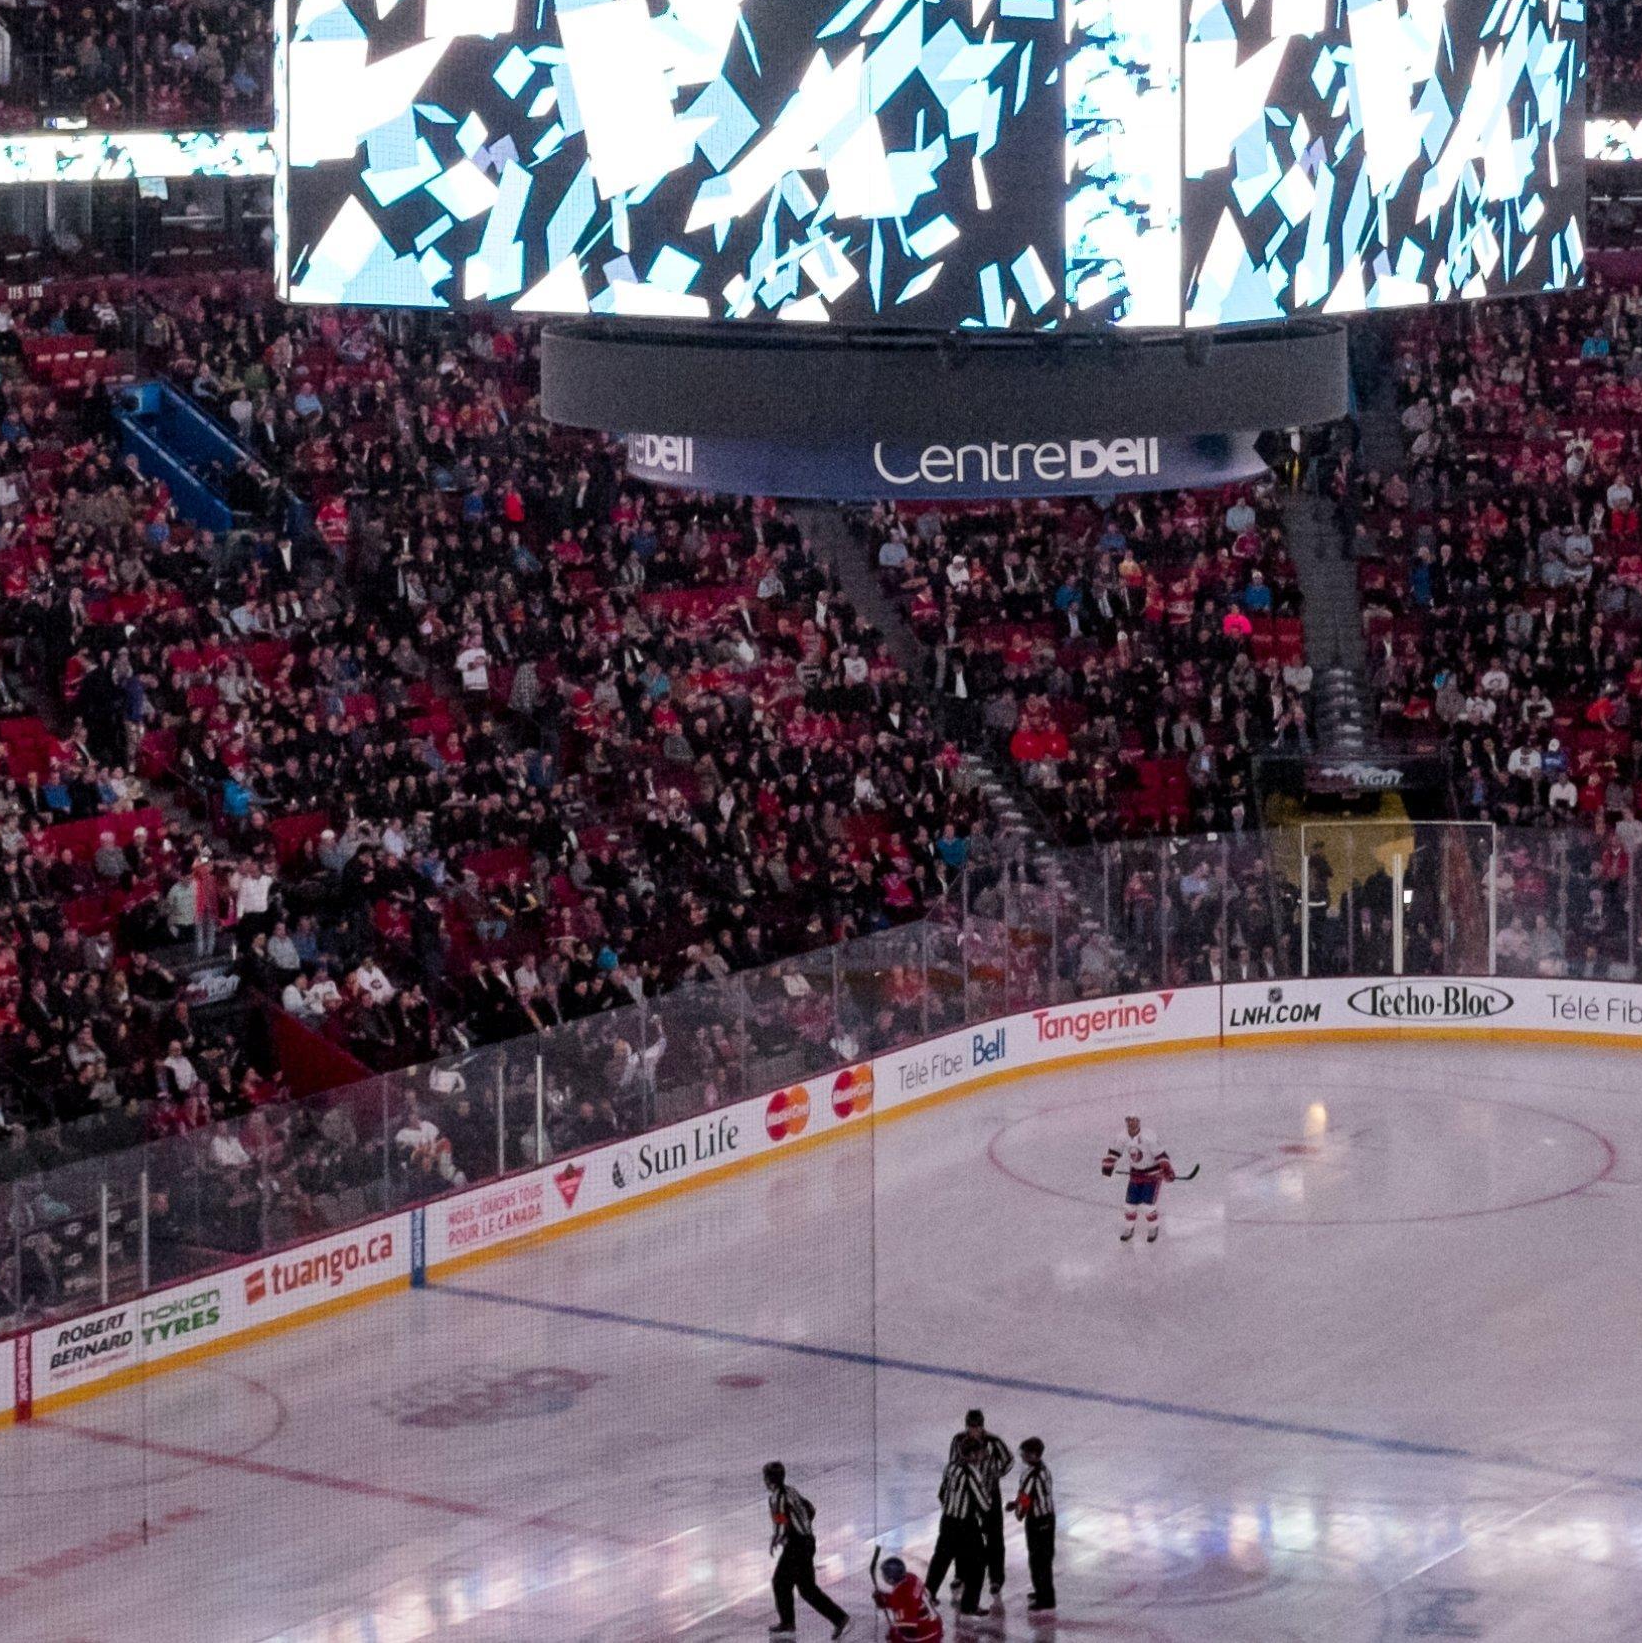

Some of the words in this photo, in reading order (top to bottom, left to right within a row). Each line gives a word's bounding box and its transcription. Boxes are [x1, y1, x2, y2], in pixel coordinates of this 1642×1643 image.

[1032, 999, 1158, 1045] Tangerine
[1229, 1003, 1322, 1027] LNH.COM
[1368, 985, 1498, 1019] Techo-Bloc
[1546, 993, 1601, 1021] Télé
[898, 1061, 929, 1092] Télé
[931, 1053, 963, 1082] Fibe
[973, 1028, 1006, 1067] Bell
[637, 1142, 688, 1180] Sun
[695, 1116, 739, 1163] Life
[448, 1223, 479, 1246] POUR
[482, 1218, 496, 1236] LE
[498, 1202, 543, 1230] CANADA
[271, 1233, 393, 1295] tuango.ca
[141, 1288, 221, 1324] nokian
[142, 1305, 221, 1346] TYRES
[57, 1312, 128, 1347] ROBERT
[49, 1330, 133, 1370] BERNARD
